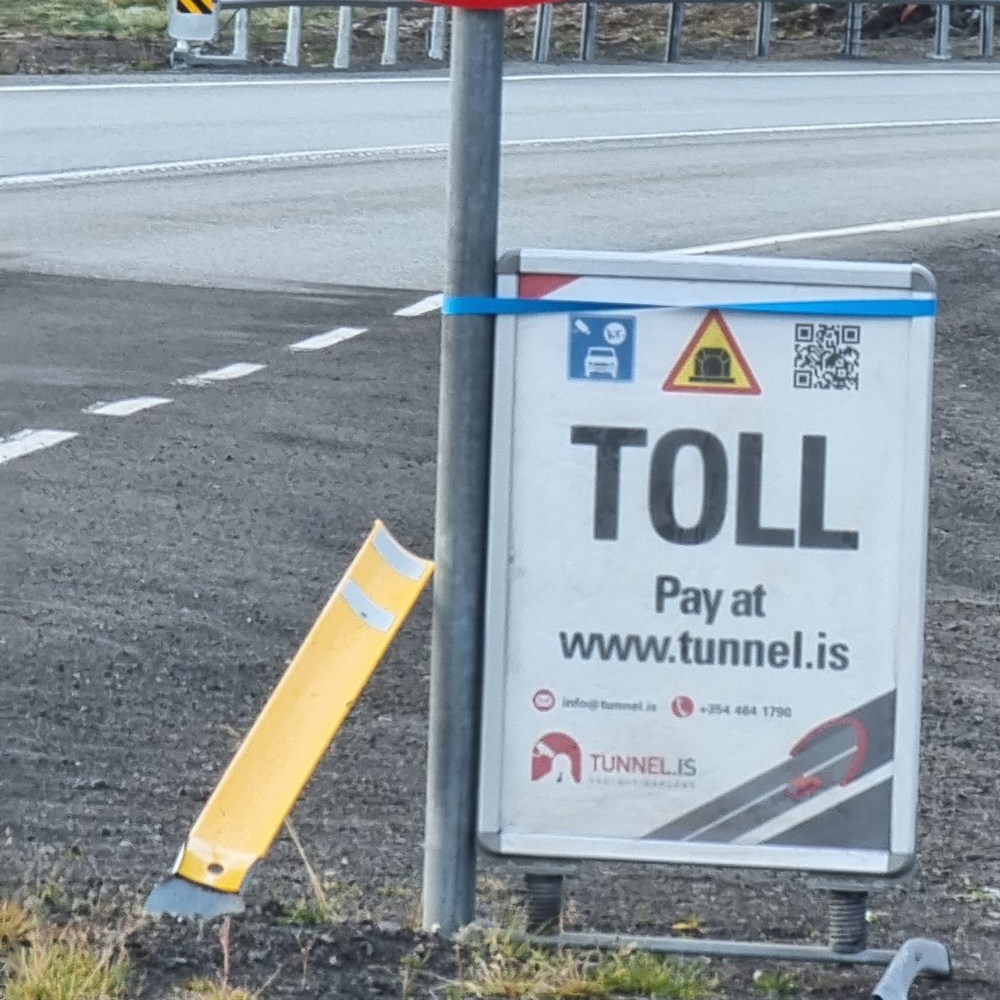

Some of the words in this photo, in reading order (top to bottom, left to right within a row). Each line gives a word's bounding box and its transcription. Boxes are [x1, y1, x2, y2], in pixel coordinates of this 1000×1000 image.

[571, 425, 859, 550] TOLL
[655, 575, 723, 625] Pay
[731, 583, 767, 618] at
[559, 631, 850, 671] www.tunnel.is
[561, 696, 657, 713] info@tunnel.is
[700, 702, 730, 715] +354
[590, 753, 697, 777] TUNNEL.IS
